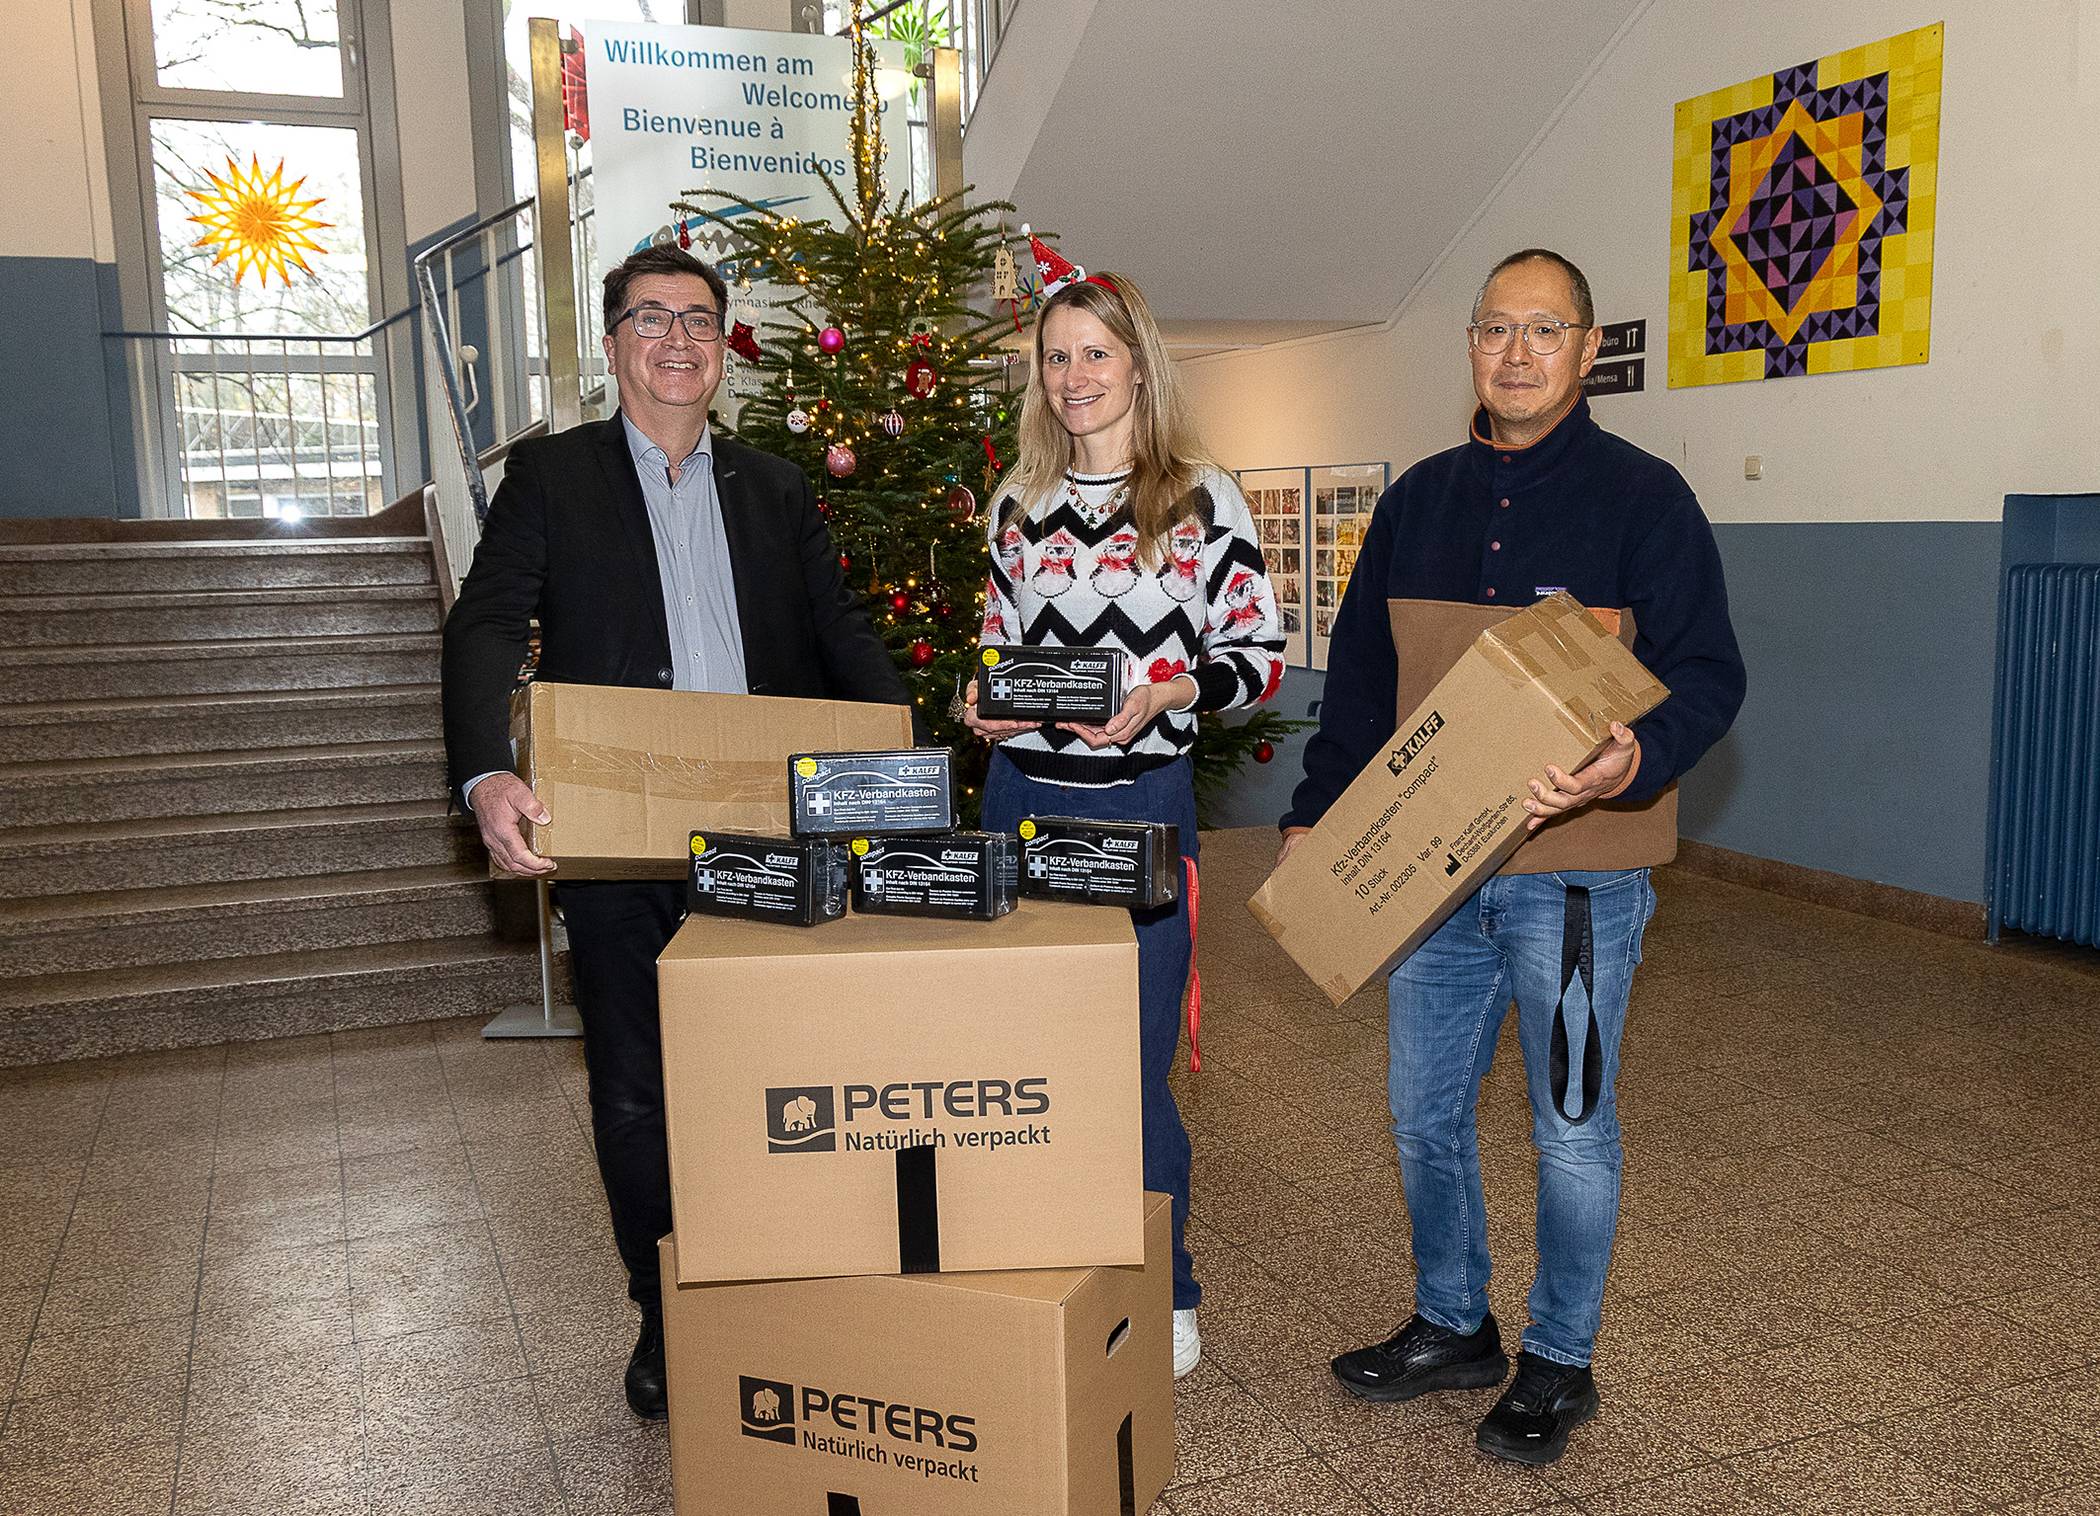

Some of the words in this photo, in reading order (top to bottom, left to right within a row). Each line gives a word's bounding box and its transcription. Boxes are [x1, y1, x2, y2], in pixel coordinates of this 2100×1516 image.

[604, 39, 766, 72] Willkommen
[777, 57, 813, 75] am
[742, 82, 859, 112] Welcome
[624, 107, 761, 138] Bienvenue
[770, 116, 784, 139] à
[691, 146, 846, 176] Bienvenidos
[1013, 679, 1103, 690] KFZ-Verbandkasten
[1405, 715, 1438, 757] KALFF
[801, 768, 831, 784] compact
[834, 788, 937, 800] KFZ-Verbandkasten
[1025, 833, 1049, 847] compact
[1114, 840, 1137, 848] KALFF
[1330, 801, 1402, 877] Kfz-Verbandkasten
[954, 852, 977, 860] KALFF
[1049, 857, 1134, 871] KFZ-Verbandkasten
[1341, 864, 1361, 886] Inhalt
[1358, 852, 1373, 868] DIN
[1371, 831, 1392, 853] 13164
[717, 870, 794, 888] KFZ-Verbandkasten
[886, 870, 975, 883] KFZ-Verbandkasten
[1355, 883, 1370, 899] 10
[1367, 867, 1389, 889] Stück
[1369, 892, 1393, 915] Art.-Nr.
[1390, 863, 1417, 892] 002305
[1417, 846, 1434, 863] Var.
[1430, 836, 1443, 849] 99
[844, 1077, 1050, 1122] PETERS
[845, 1127, 946, 1151] Natürlich
[954, 1124, 1051, 1150] verpackt
[801, 1387, 978, 1453] PETERS
[803, 1431, 887, 1464] Natürlich
[893, 1453, 978, 1483] verpackt
